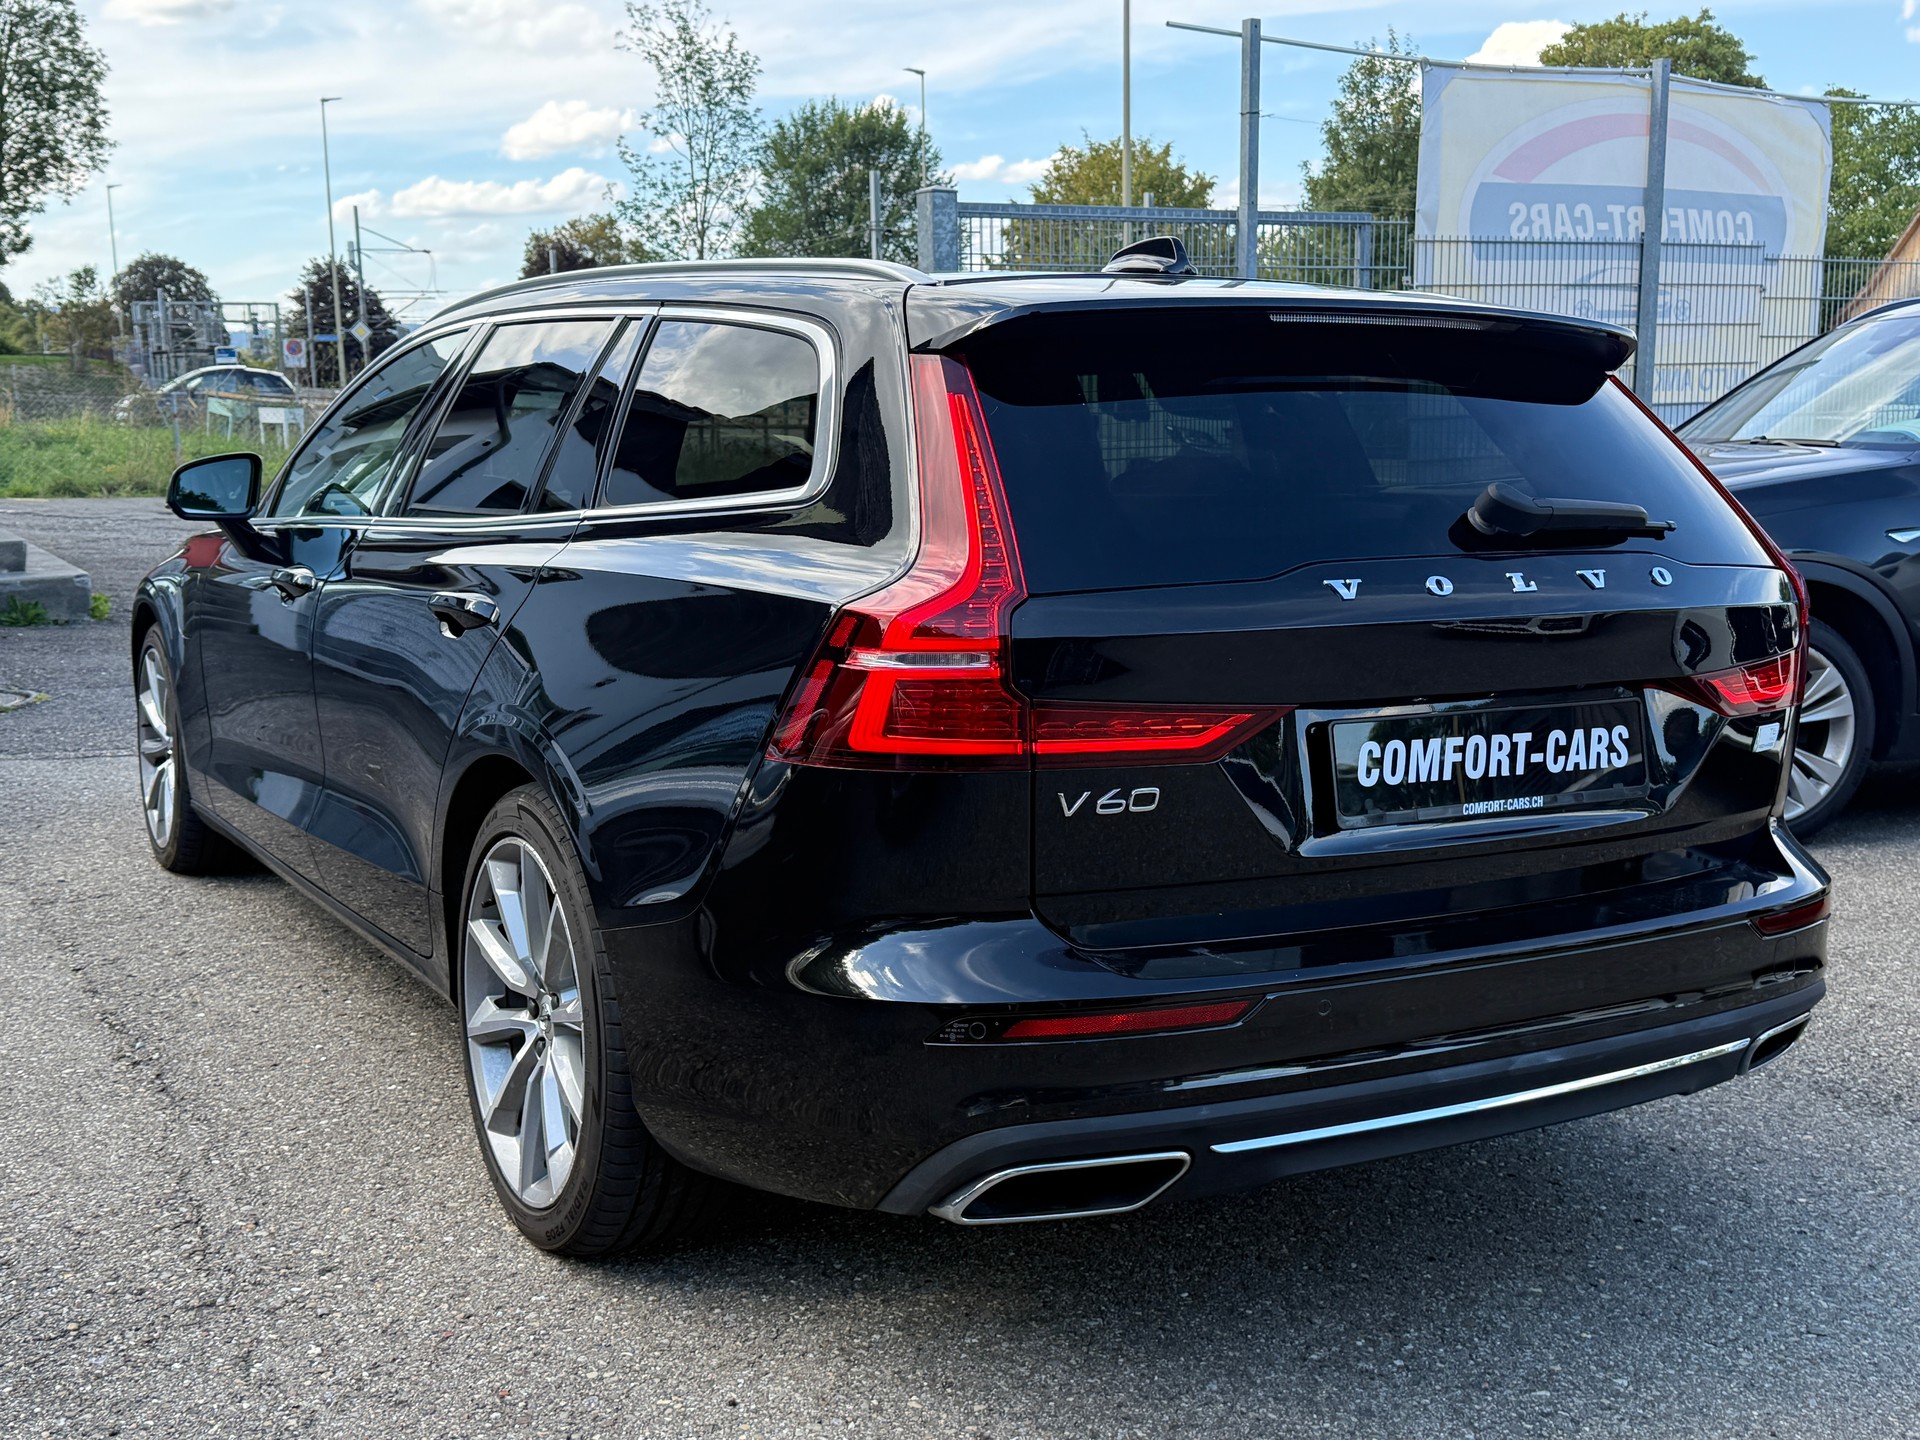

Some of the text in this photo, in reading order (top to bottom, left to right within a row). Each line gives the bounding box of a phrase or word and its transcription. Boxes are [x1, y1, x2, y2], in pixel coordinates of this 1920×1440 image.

[1323, 566, 1673, 600] VOLVO
[1357, 725, 1630, 788] COMFORT-CARS
[1058, 787, 1160, 817] V60
[1462, 795, 1544, 815] COMFORT-CARS.CH
